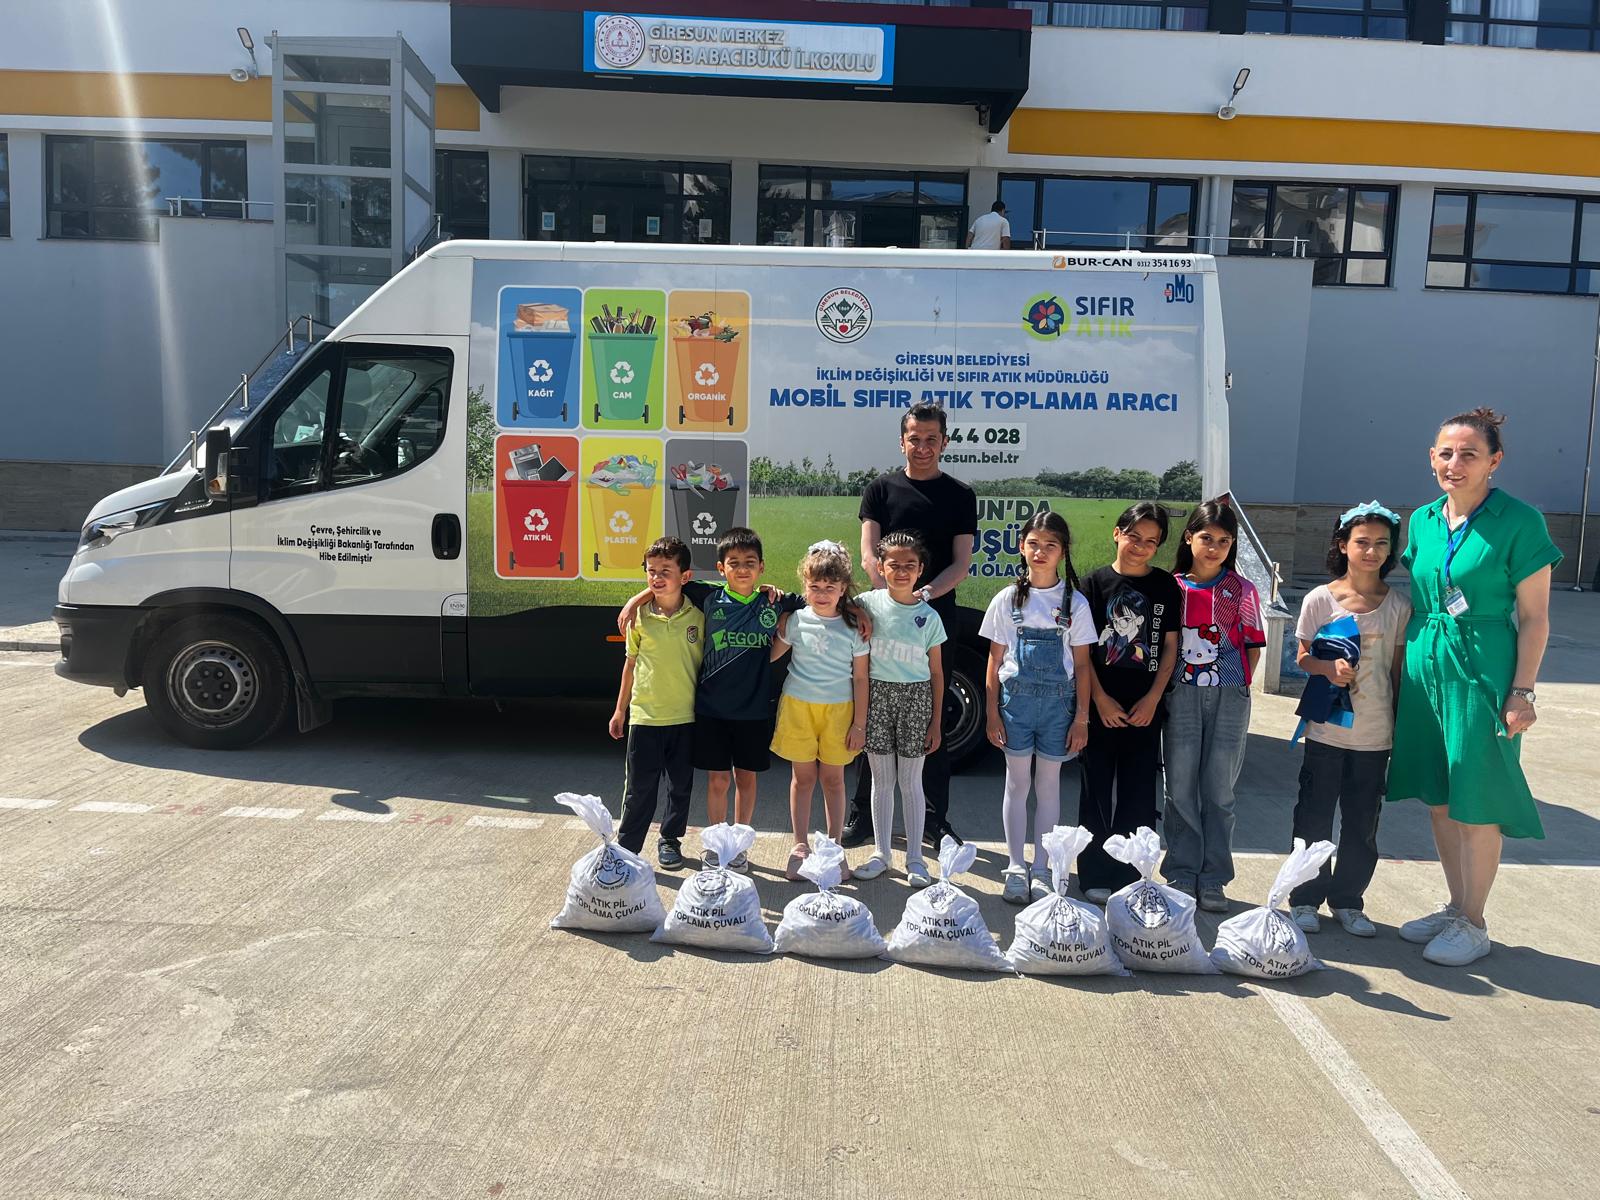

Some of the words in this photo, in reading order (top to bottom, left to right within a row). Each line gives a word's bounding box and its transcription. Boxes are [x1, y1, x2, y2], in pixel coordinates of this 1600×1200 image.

[649, 23, 718, 42] GİRESUN
[721, 29, 785, 45] MERKEZ
[649, 45, 694, 64] TOBB
[695, 46, 792, 69] ABACIBÜKÜ
[795, 48, 877, 72] İLKOKULU
[1067, 258, 1132, 267] BUR-CAN
[1152, 259, 1168, 268] 354
[1170, 259, 1179, 268] 16
[1181, 259, 1192, 268] 93
[1165, 274, 1194, 304] DMO
[1075, 296, 1134, 316] SIFIR
[1076, 318, 1135, 337] ATIK
[896, 351, 953, 366] GİRESUN
[956, 352, 1030, 366] BELEDİYESİ
[816, 367, 851, 381] İKLİM
[855, 368, 934, 384] DEĞİŞİKLİĞİ
[937, 371, 954, 382] VE
[957, 371, 989, 382] SIFIR
[992, 371, 1021, 383] ATIK
[1024, 370, 1109, 383] MÜDÜRLÜĞÜ
[528, 388, 554, 398] KAĞIT
[613, 391, 632, 399] CAM
[687, 391, 726, 400] ORGANİK
[770, 383, 846, 407] MOBİL
[853, 389, 912, 408] SIFIR
[920, 390, 973, 408] ATIK
[981, 391, 1098, 410] TOPLAMA
[1106, 392, 1178, 411] ARACI
[984, 428, 1020, 444] 028
[310, 525, 335, 535] Çevre,
[336, 526, 371, 536] Şehircilik
[541, 533, 552, 541] PİL
[277, 534, 296, 546] İklim
[297, 538, 336, 549] Değişikliği
[338, 540, 372, 551] Bakanlığı
[374, 541, 414, 550] Tarafından
[605, 536, 637, 544] PLASTİK
[692, 537, 718, 545] METAL
[320, 552, 336, 560] Hibe
[338, 553, 372, 564] Edilmiştir
[576, 894, 613, 919] TOPLAMA
[615, 899, 646, 919] ÇUVALI
[591, 896, 611, 909] ATIK
[613, 899, 627, 909] PİL
[690, 906, 710, 917] ATIK
[712, 907, 726, 917] PİL
[674, 910, 711, 929] TOPLAMA
[714, 916, 747, 930] ÇUVALI
[922, 916, 941, 927] ATIK
[944, 917, 958, 927] PİL
[906, 922, 944, 939] TOPLAMA
[1049, 941, 1071, 952] ATIK
[1074, 943, 1088, 952] PİL
[1112, 934, 1157, 960] TOPLAMA
[1160, 943, 1191, 960] ÇUVALI
[1132, 937, 1155, 949] ATIK
[1157, 938, 1172, 949] PİL
[1029, 941, 1073, 963] TOPLAMA
[1076, 945, 1106, 963] ÇUVALI
[1267, 958, 1289, 970] ATIK
